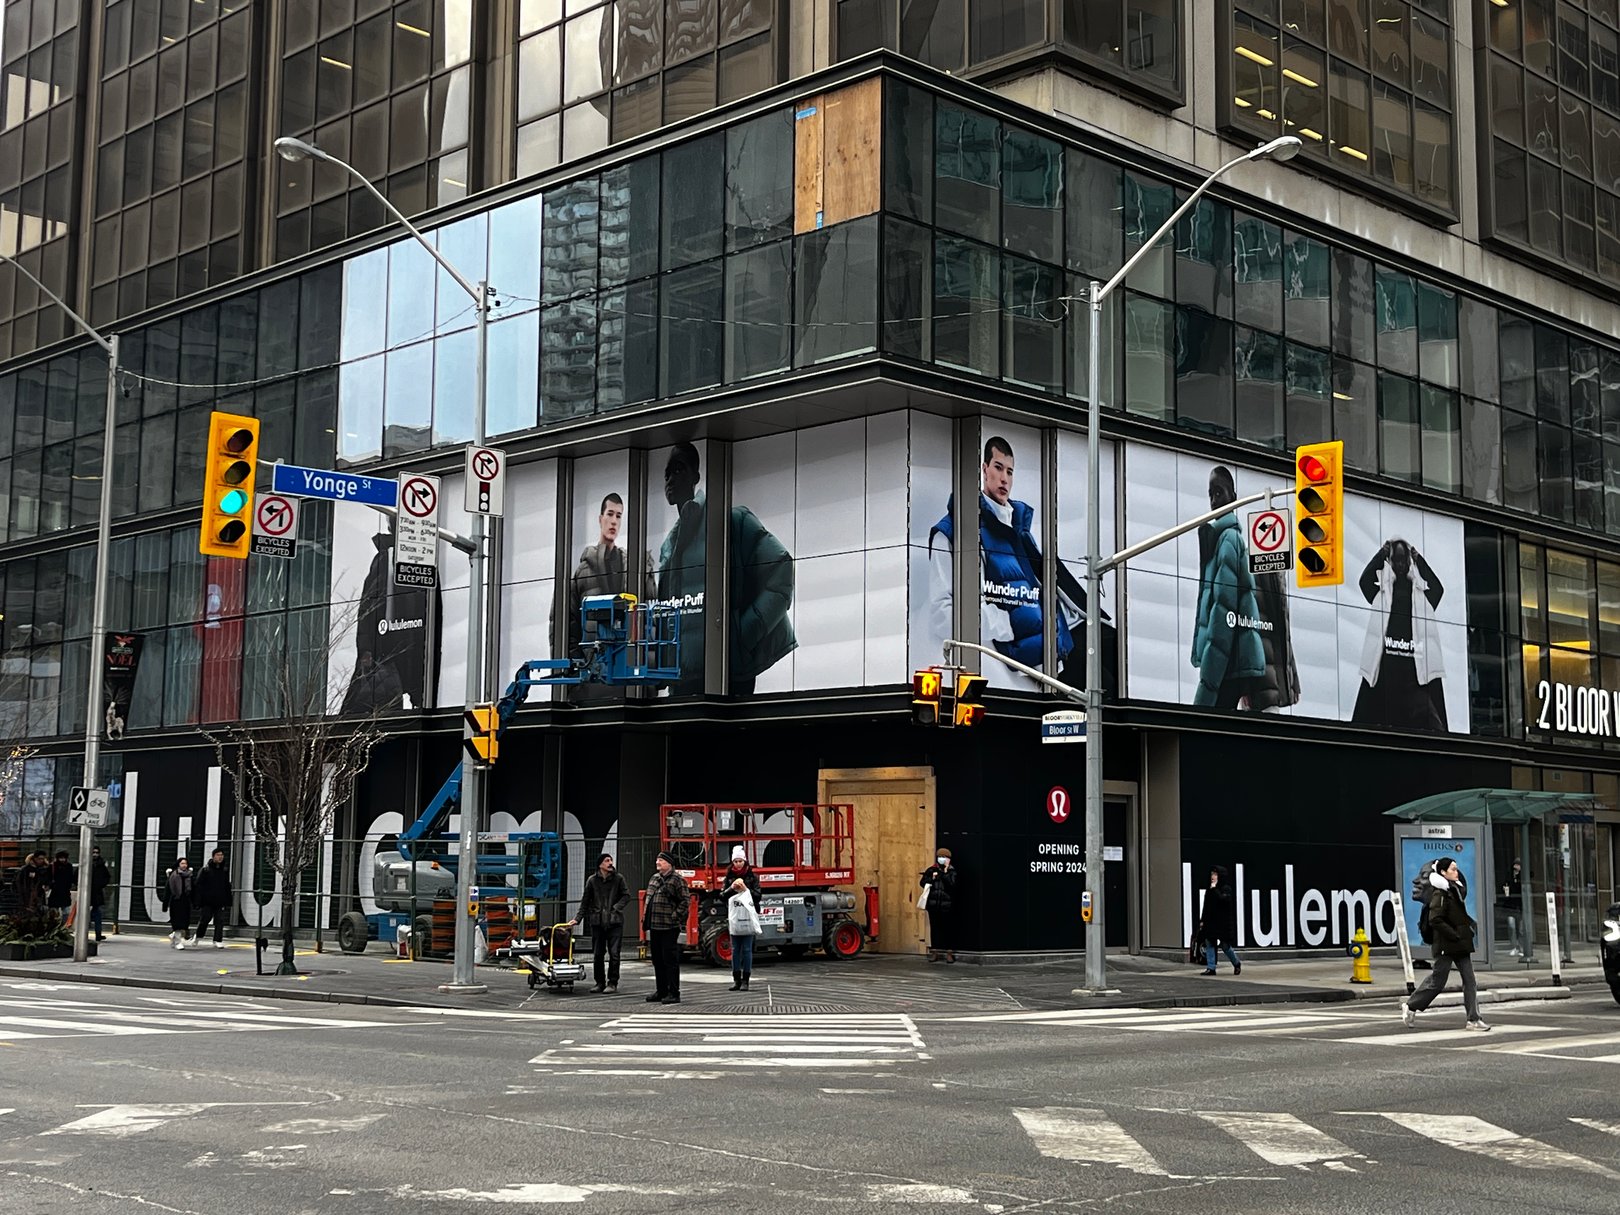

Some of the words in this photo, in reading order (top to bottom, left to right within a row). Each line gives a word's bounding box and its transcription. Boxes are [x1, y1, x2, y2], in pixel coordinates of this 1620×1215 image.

[303, 471, 357, 498] Yonge
[362, 479, 371, 489] St
[258, 536, 289, 547] BICYCLES
[256, 545, 289, 556] EXCEPTED
[1255, 553, 1285, 563] BICYCLES
[400, 565, 432, 575] BICYCLES
[1254, 562, 1286, 571] EXCEPTED
[397, 574, 433, 584] EXCEPTED
[984, 580, 1019, 597] Wunder
[1020, 586, 1040, 600] Puff
[685, 592, 704, 606] Puff
[389, 619, 422, 631] lululemon
[1238, 614, 1273, 631] lululemon
[1385, 636, 1410, 650] Wunder
[1539, 680, 1550, 729] 2
[1556, 682, 1610, 736] BLOOR
[1049, 725, 1066, 735] Bloor
[1067, 726, 1073, 734] St
[1073, 724, 1079, 734] W
[1038, 843, 1080, 855] OPENING
[1030, 861, 1063, 873] SPRING
[1065, 862, 1087, 873] 2024
[1182, 862, 1397, 948] llulemo
